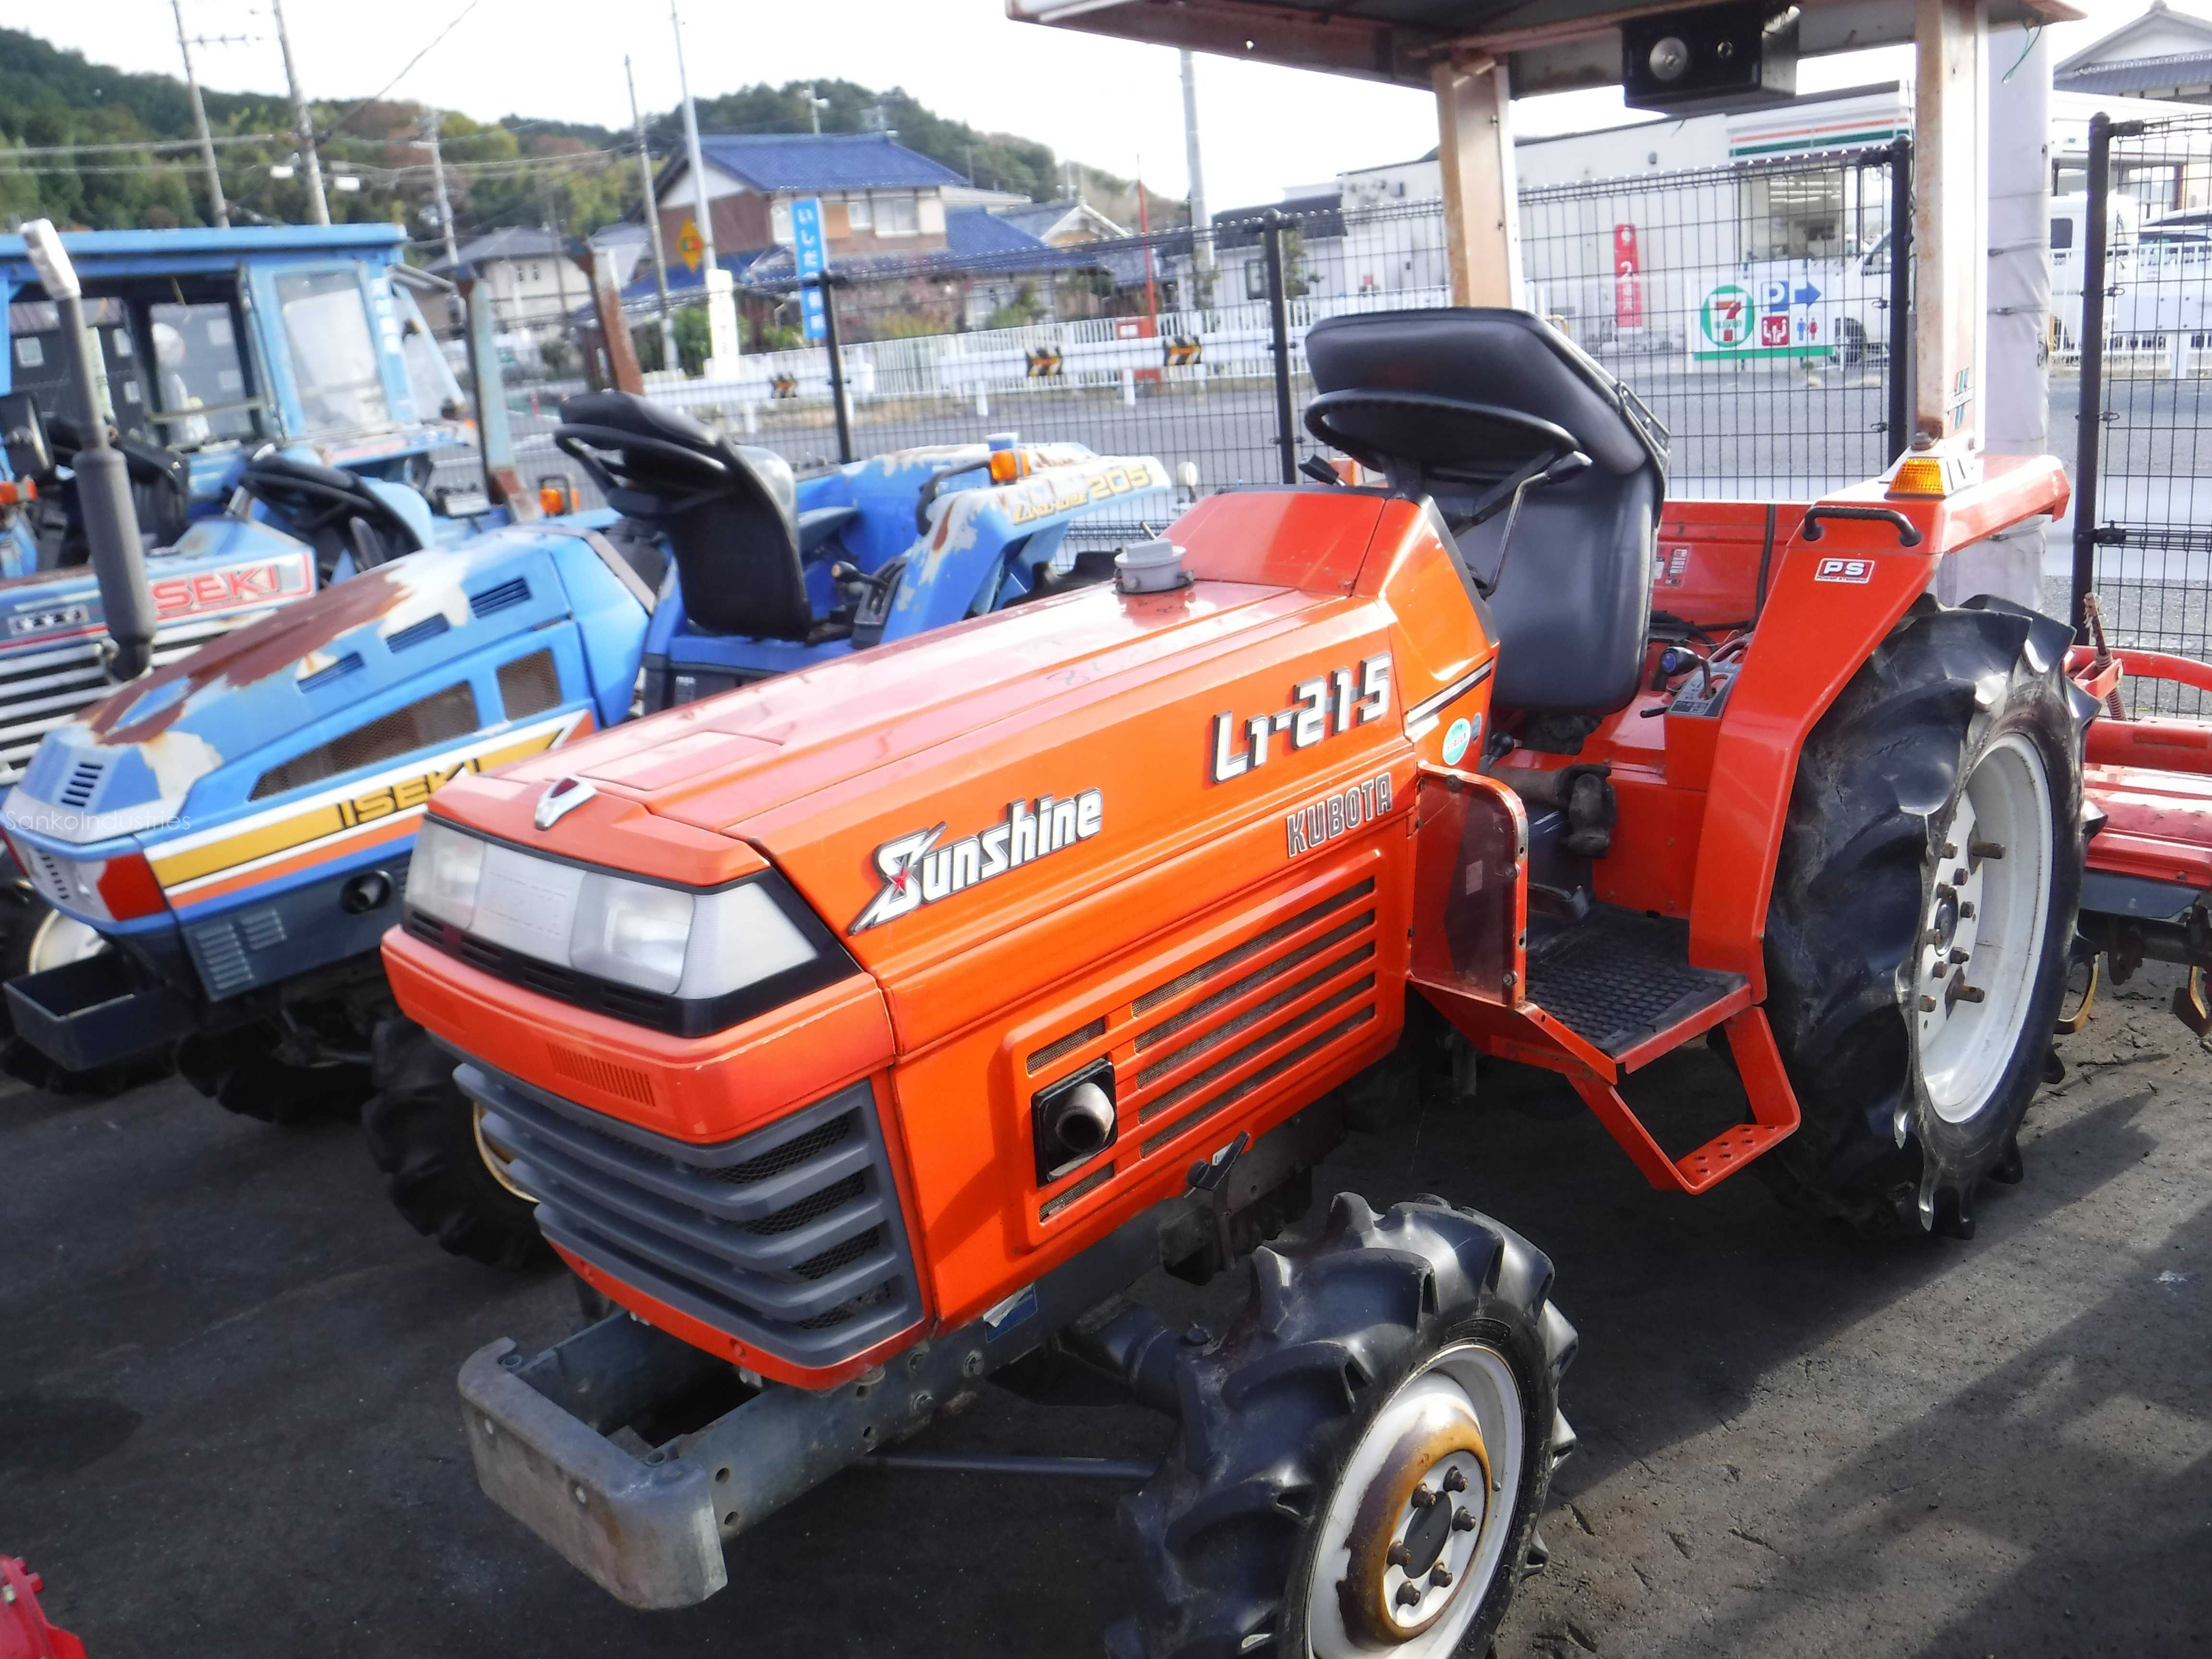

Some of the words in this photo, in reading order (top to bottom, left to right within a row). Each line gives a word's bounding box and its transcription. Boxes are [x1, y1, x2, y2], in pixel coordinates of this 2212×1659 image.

[1087, 464, 1153, 501] 205
[151, 565, 280, 611] SEKI
[1823, 561, 1865, 576] PS
[1286, 771, 1392, 858] KUBOTA
[848, 787, 1103, 936] Sunshine
